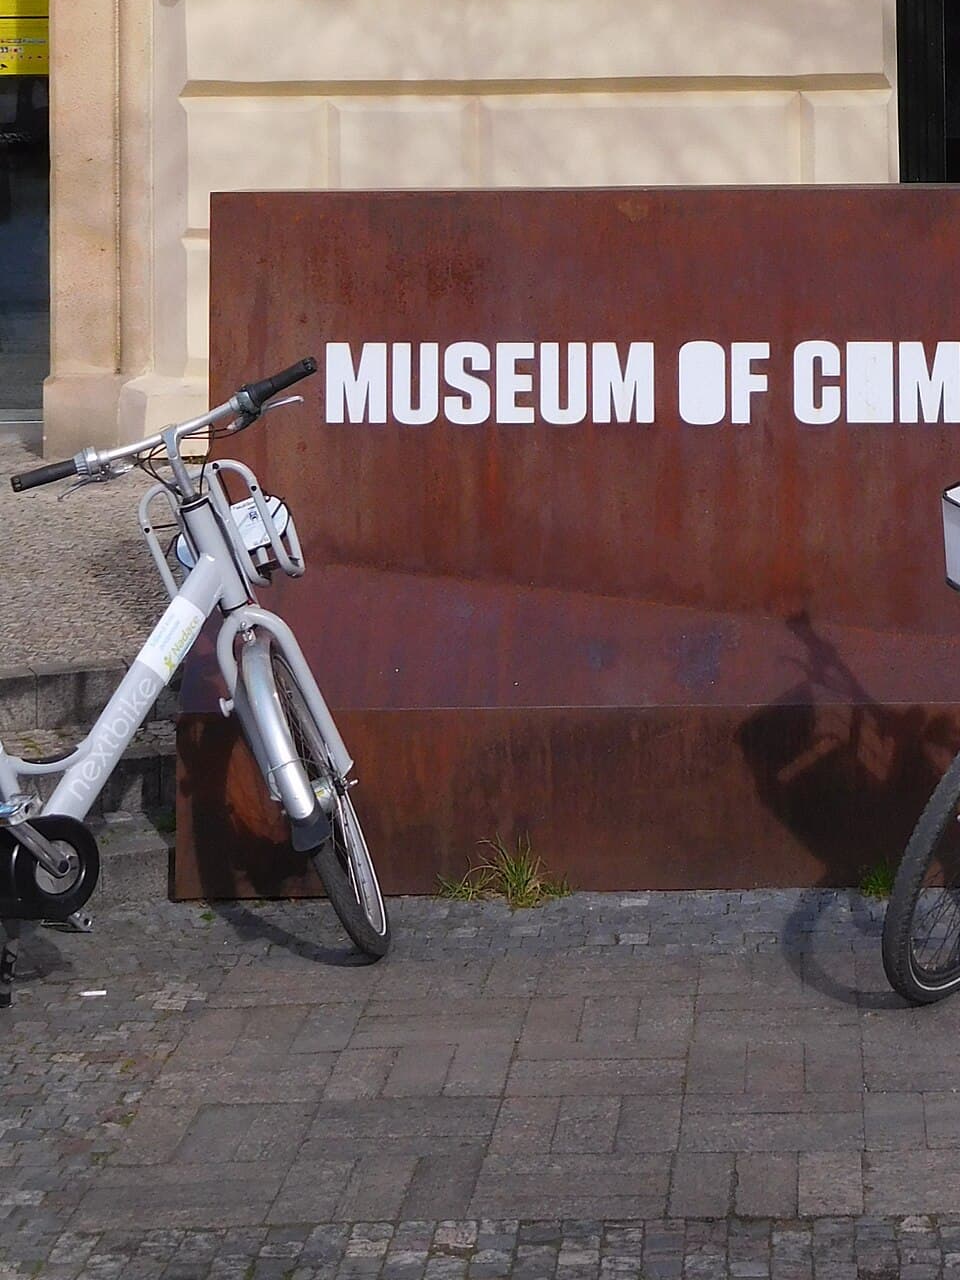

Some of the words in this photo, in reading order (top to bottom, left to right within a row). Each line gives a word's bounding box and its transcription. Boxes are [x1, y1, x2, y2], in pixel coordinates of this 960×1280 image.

[324, 341, 656, 425] MUSEUM
[677, 340, 770, 426] OF
[69, 677, 157, 802] nextbike
